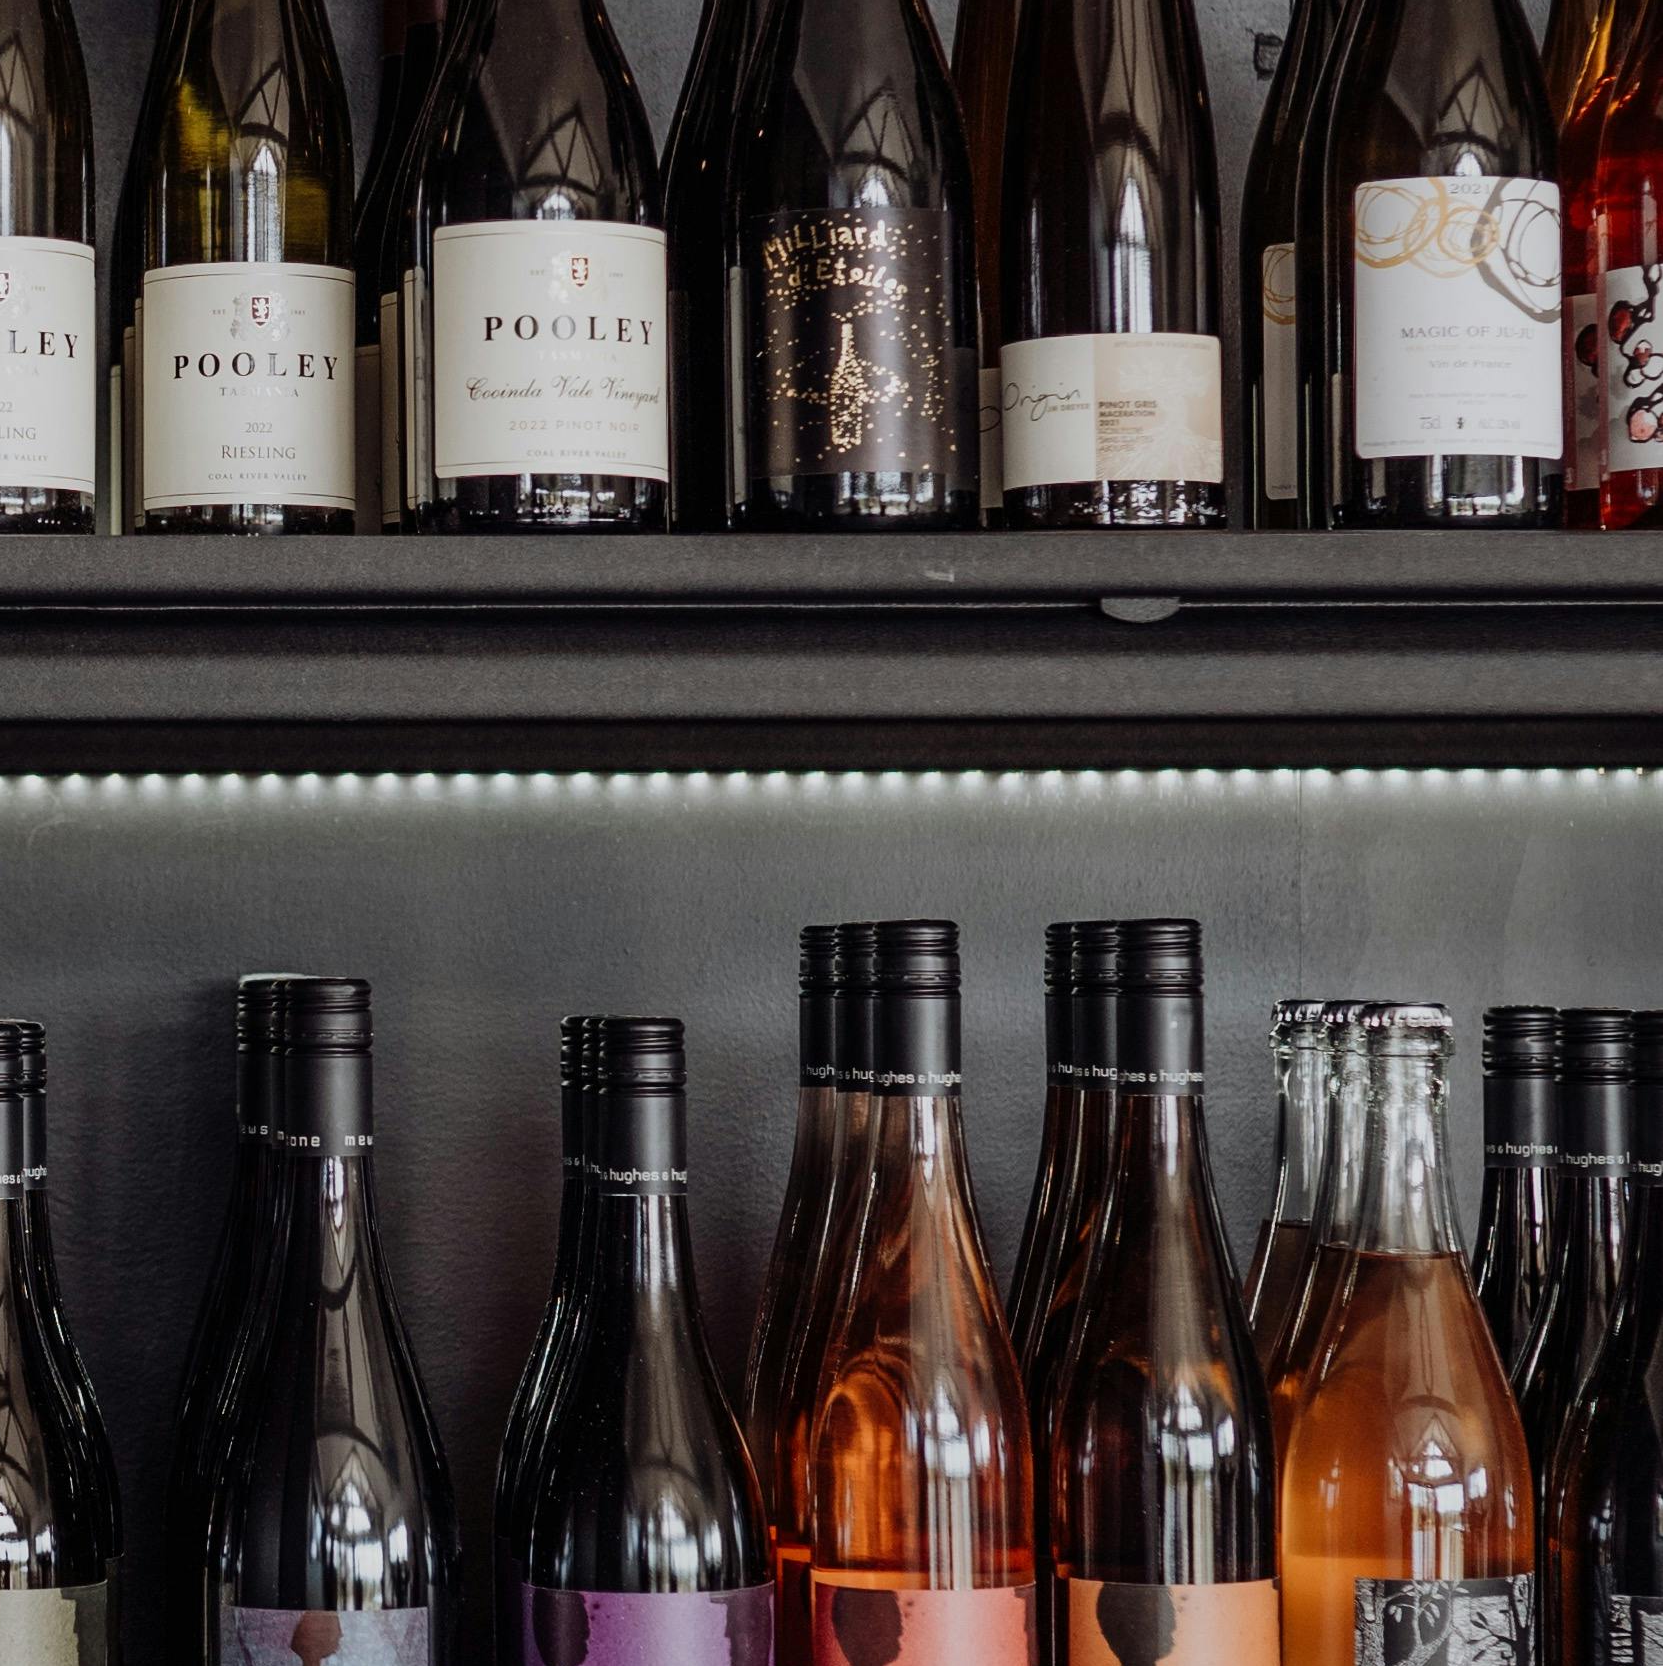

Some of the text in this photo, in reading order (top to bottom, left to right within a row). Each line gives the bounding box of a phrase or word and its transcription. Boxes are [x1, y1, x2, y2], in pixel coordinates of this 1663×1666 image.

[1450, 183, 1490, 194] 2021
[484, 315, 653, 346] POOLEY
[1400, 325, 1459, 339] MAGIC
[1467, 326, 1490, 337] OF
[173, 352, 338, 380] POOLEY
[552, 375, 593, 398] Vale
[600, 376, 661, 409] Vineyard
[245, 422, 272, 433] 2022
[509, 420, 639, 432] 2022 PINOT NOIR
[221, 444, 296, 459] RIESLING
[1505, 1142, 1553, 1157] hughes
[1566, 1152, 1614, 1167] hughes
[609, 1168, 659, 1185] hughes
